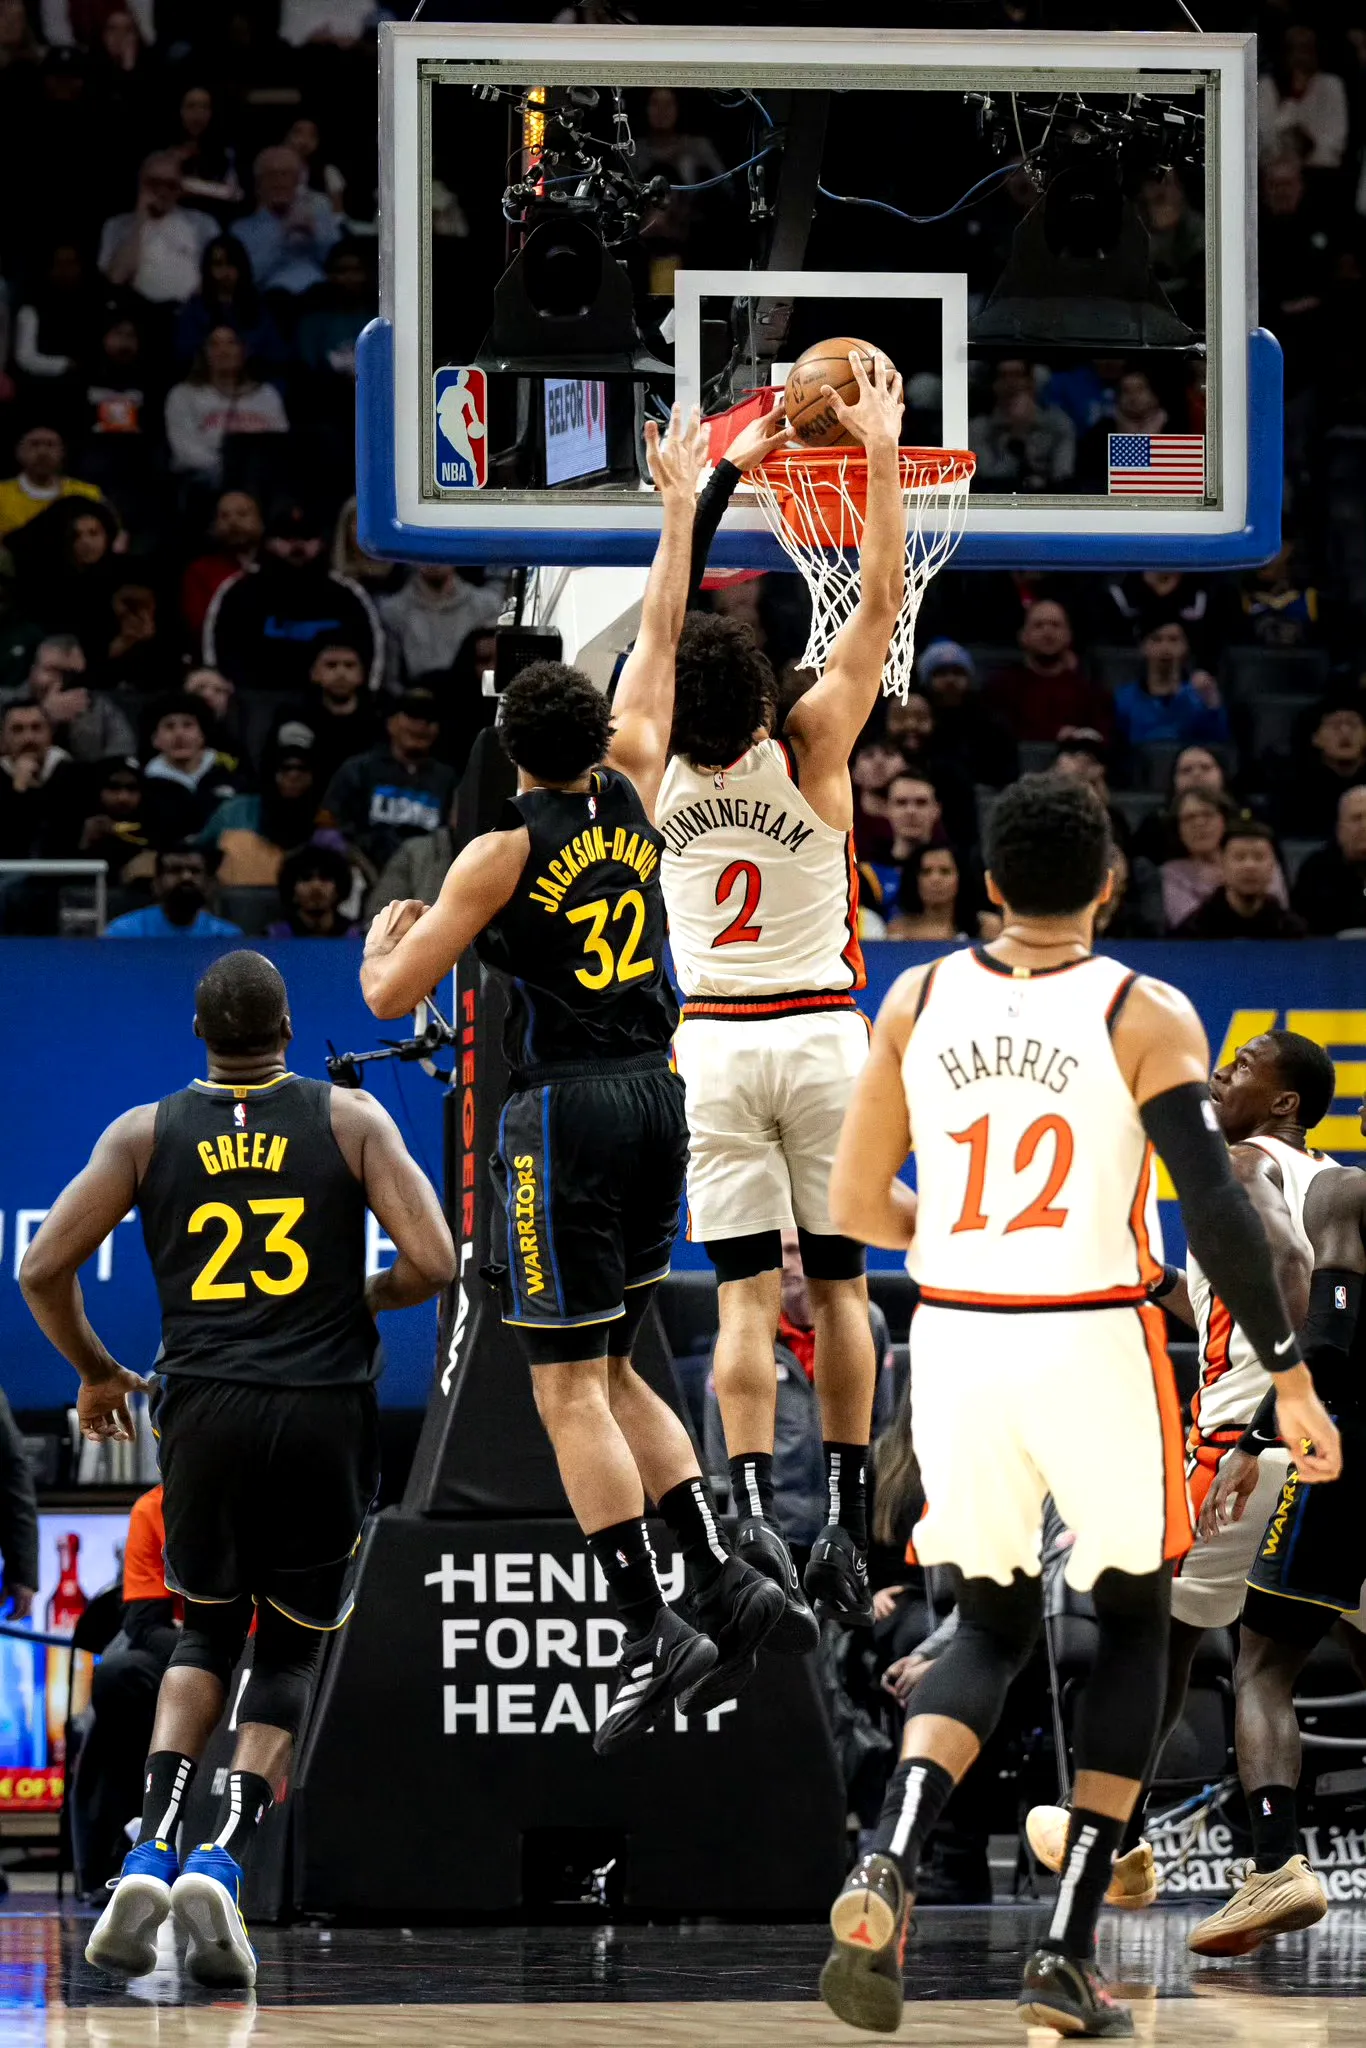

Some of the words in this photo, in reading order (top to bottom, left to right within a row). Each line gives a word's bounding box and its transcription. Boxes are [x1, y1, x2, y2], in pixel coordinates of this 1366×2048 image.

[548, 380, 585, 437] BELFOR
[441, 462, 468, 482] NBA
[529, 826, 658, 913] JACKSON-DAVIS
[711, 859, 762, 949] 2
[565, 889, 655, 990] 32
[938, 1036, 1079, 1093] HARRIS
[197, 1132, 288, 1175] GREEN
[461, 988, 476, 1237] FIEGER
[944, 1112, 1075, 1236] 12
[187, 1197, 309, 1301] 23
[514, 1155, 544, 1296] WARRIORS
[440, 1241, 474, 1397] LAW
[442, 1617, 628, 1669] FORD
[1147, 1818, 1233, 1857] ittle
